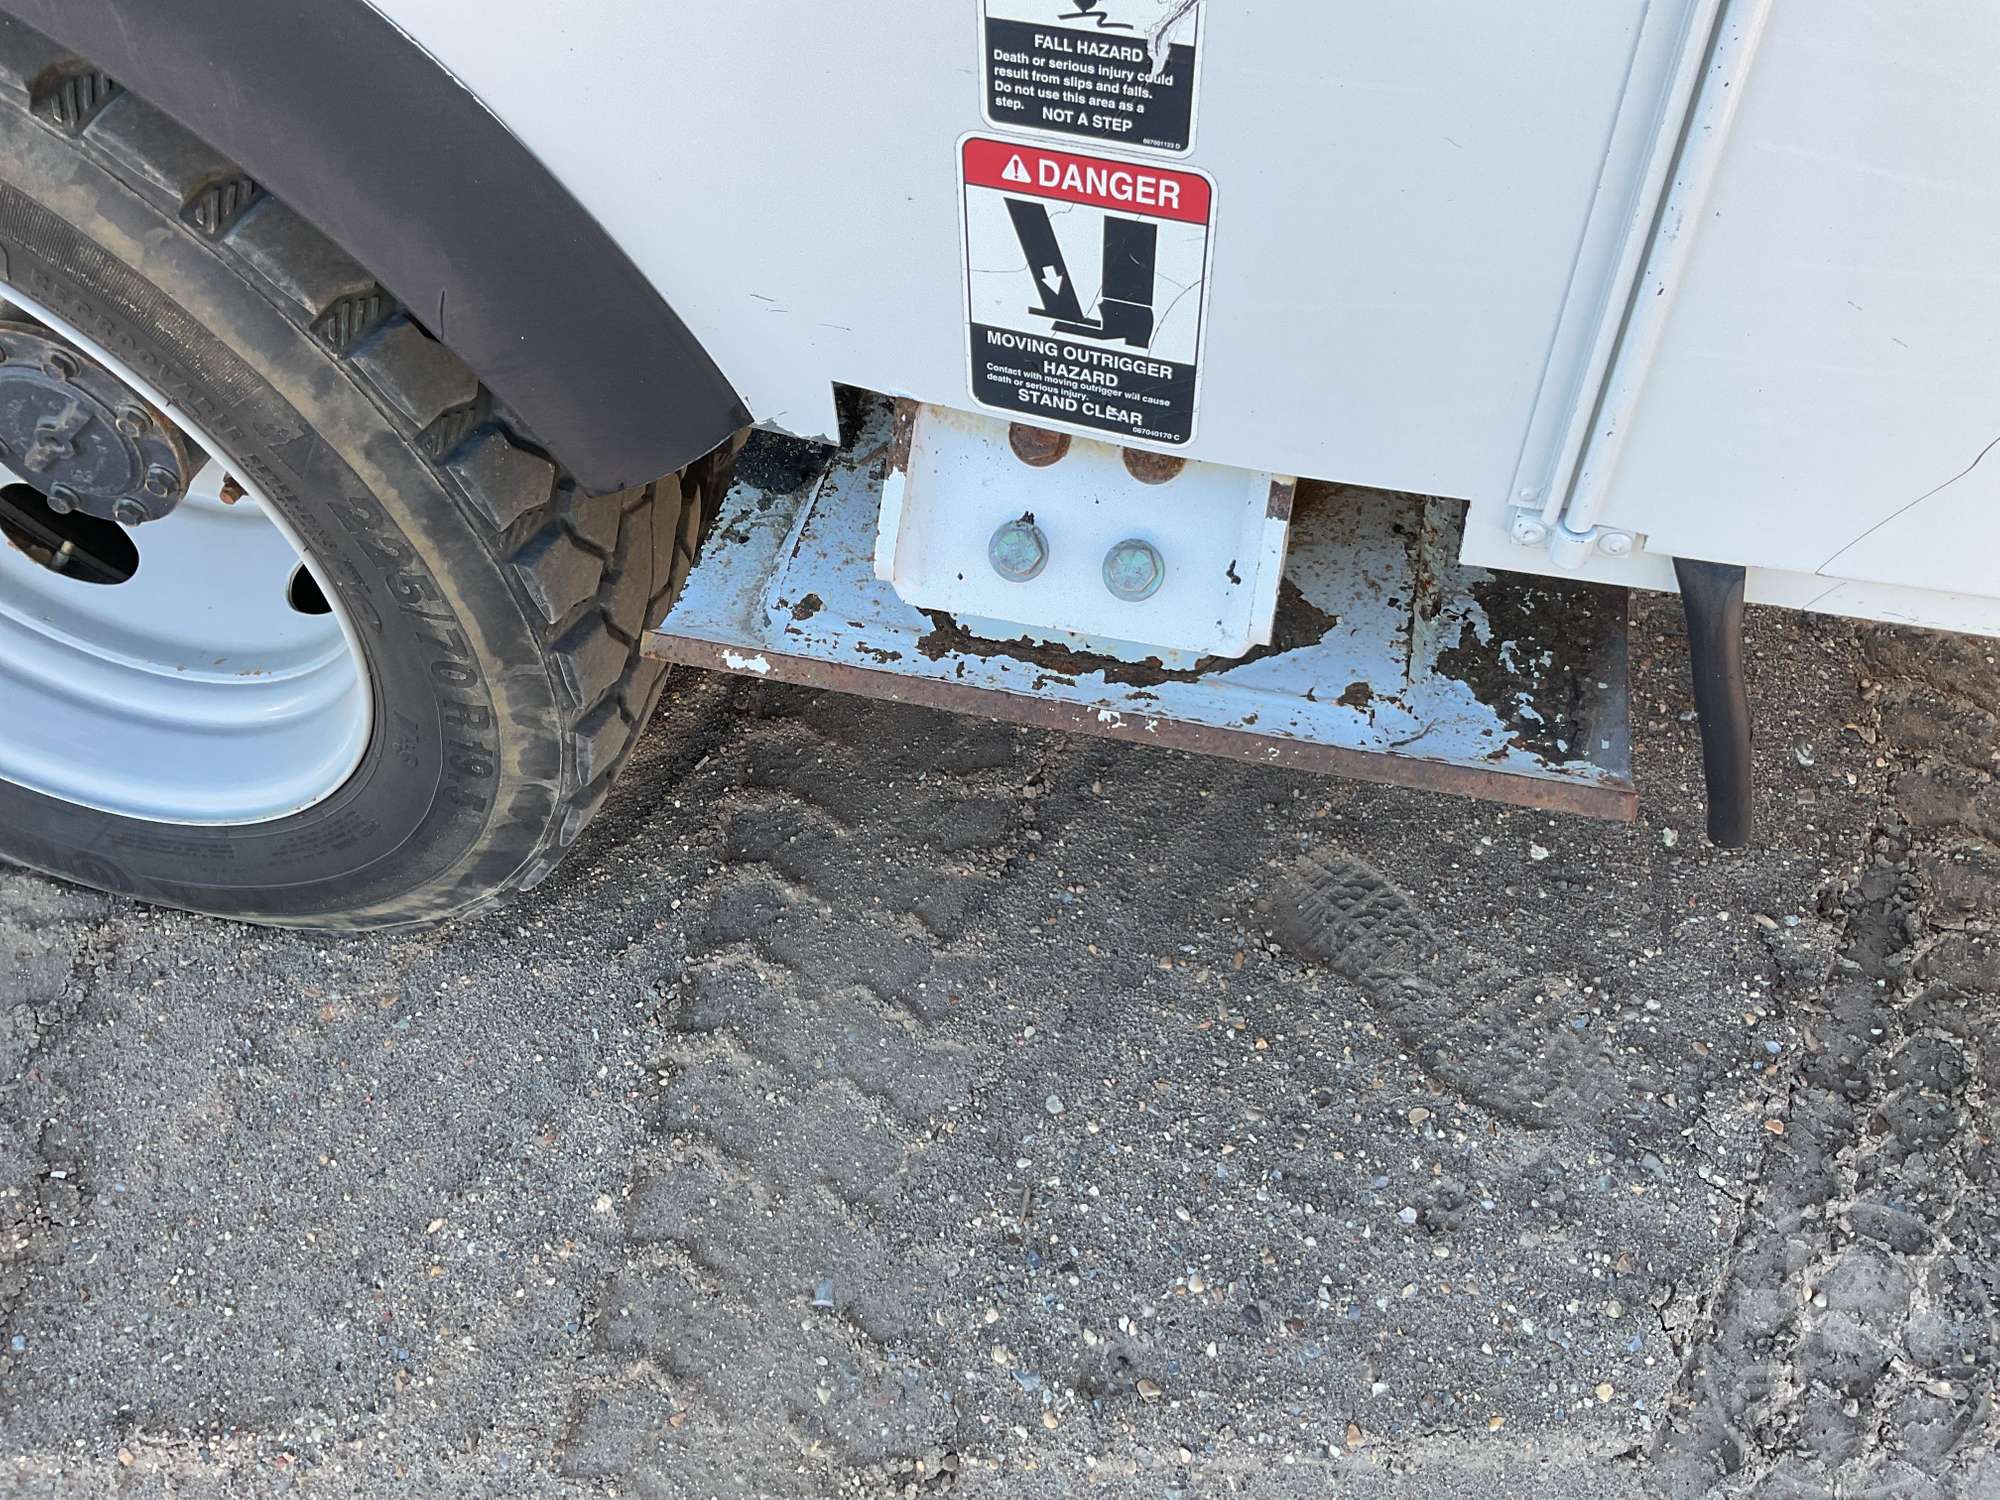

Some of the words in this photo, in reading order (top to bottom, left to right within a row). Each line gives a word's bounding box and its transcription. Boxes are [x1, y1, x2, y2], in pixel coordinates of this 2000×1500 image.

[1034, 33, 1073, 53] FALL
[1077, 39, 1143, 62] HAZARD
[993, 48, 1029, 65] Death
[1032, 57, 1046, 67] or
[1048, 59, 1095, 74] serious
[1098, 64, 1134, 82] injury
[1137, 72, 1173, 86] could
[994, 66, 1029, 80] result
[1031, 70, 1060, 85] from
[1063, 76, 1093, 91] slips
[1096, 82, 1120, 94] and
[1122, 84, 1153, 99] falls.
[994, 79, 1012, 93] Do
[1014, 85, 1035, 96] not
[1037, 88, 1060, 100] use
[1062, 91, 1086, 104] this
[1088, 97, 1115, 109] area
[1118, 101, 1134, 112] as
[1136, 104, 1145, 113] a
[995, 96, 1025, 111] step.
[1042, 106, 1074, 123] NOT
[1077, 112, 1089, 126] A
[1092, 114, 1133, 132] STEP
[1038, 158, 1181, 209] DANGER
[987, 330, 1058, 357] MOVING
[1063, 346, 1172, 380] OUTRIGGER
[986, 362, 1021, 376] Contact
[1023, 371, 1042, 380] with
[1044, 375, 1078, 390] moving
[1080, 383, 1122, 398] outrigger
[1124, 392, 1140, 401] will
[1142, 396, 1171, 407] cause
[986, 373, 1011, 384] death
[1025, 381, 1058, 394] serious
[1060, 388, 1089, 401] injury.
[1043, 360, 1118, 387] HAZARD
[1018, 388, 1077, 412] STAND
[1082, 402, 1142, 426] CLEAR
